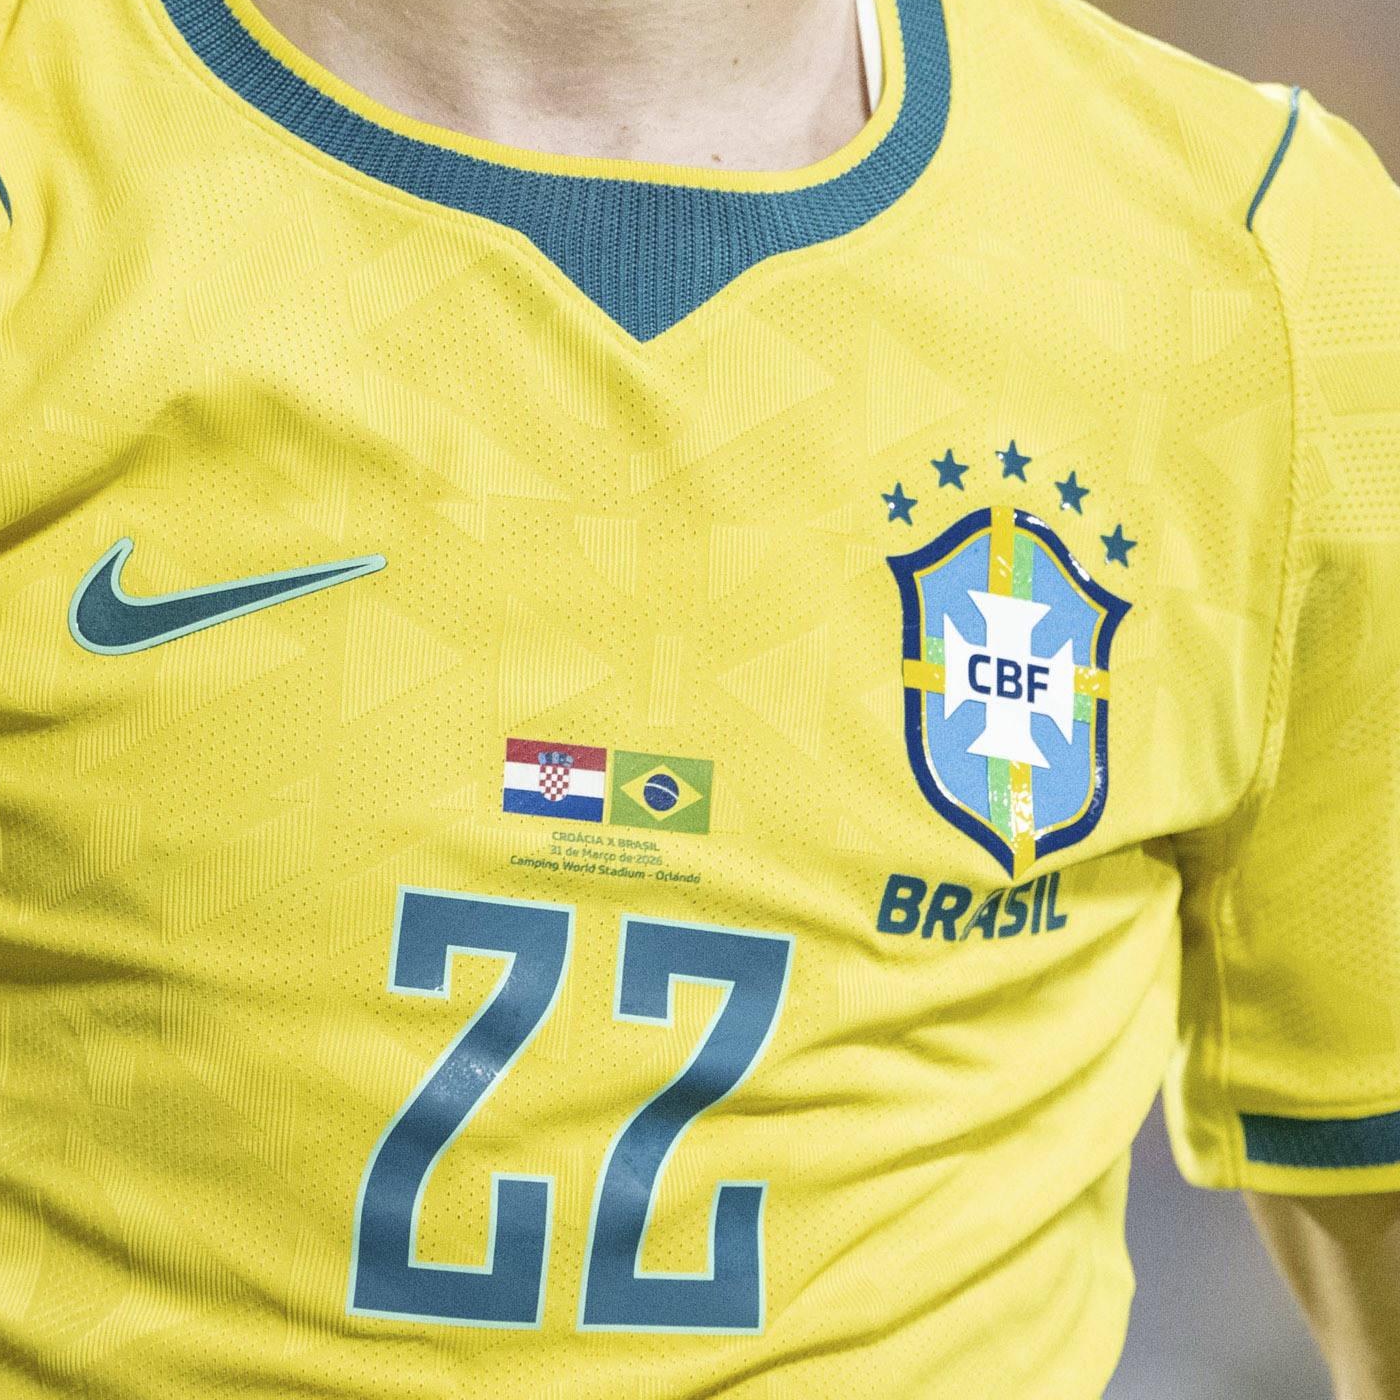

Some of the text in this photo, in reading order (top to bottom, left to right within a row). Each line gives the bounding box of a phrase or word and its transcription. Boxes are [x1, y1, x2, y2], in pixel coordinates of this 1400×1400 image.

[967, 653, 1050, 704] CBF
[551, 831, 604, 846] CROÁCIA
[618, 838, 661, 852] BRASIL
[551, 845, 561, 855] 31
[565, 847, 579, 857] de
[619, 853, 633, 863] de
[635, 855, 663, 866] 2026
[510, 855, 560, 872] Camping
[563, 861, 596, 873] World
[598, 865, 646, 879] Stadium
[655, 870, 701, 884] Orlando
[876, 870, 1069, 943] BRASIL
[346, 883, 797, 1337] 22
